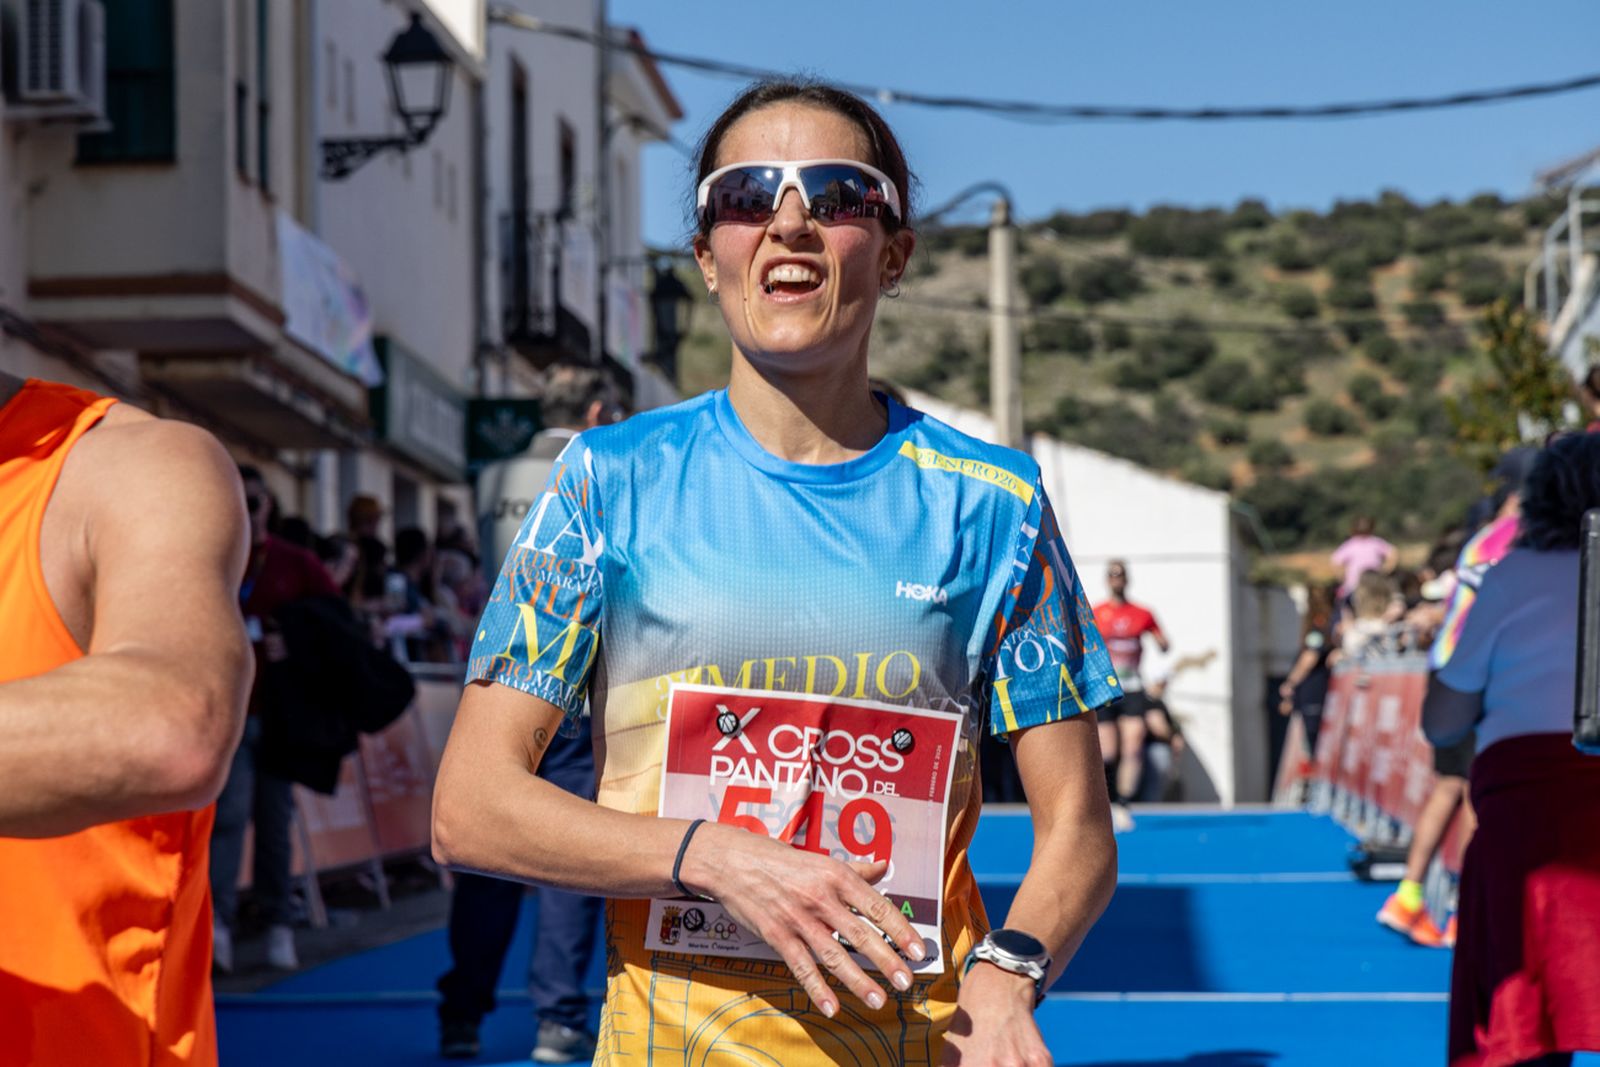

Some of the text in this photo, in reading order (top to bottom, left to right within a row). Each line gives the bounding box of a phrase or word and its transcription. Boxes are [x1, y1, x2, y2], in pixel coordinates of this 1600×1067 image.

[895, 580, 949, 606] HOKA
[711, 704, 905, 773] X CROSS
[709, 755, 900, 800] PANTANO DEL
[717, 785, 893, 871] 549
